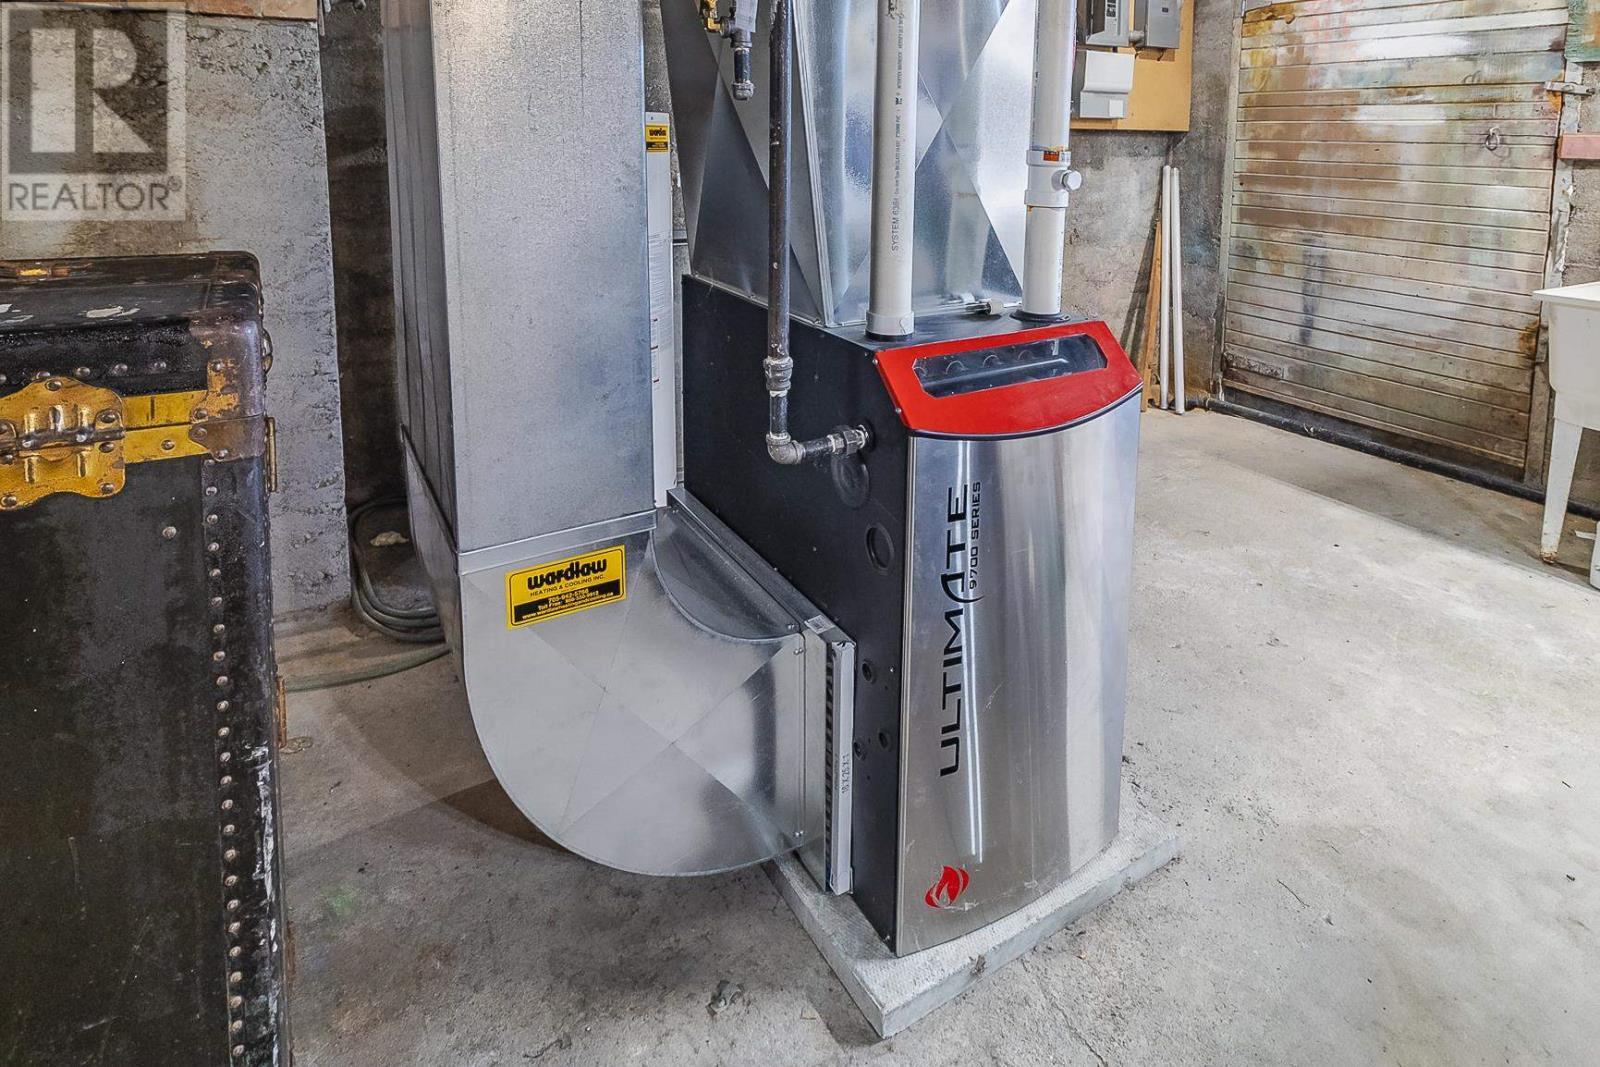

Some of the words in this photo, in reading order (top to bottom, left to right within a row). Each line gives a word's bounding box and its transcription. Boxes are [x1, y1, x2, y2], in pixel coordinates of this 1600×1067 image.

[891, 216, 900, 252] SYSTEM
[971, 481, 981, 540] SERIES
[527, 558, 607, 590] wardlaw
[530, 586, 558, 597] HEATING
[564, 577, 592, 588] COOLING
[970, 546, 979, 590] 9700
[940, 484, 985, 777] ULTIMATE
